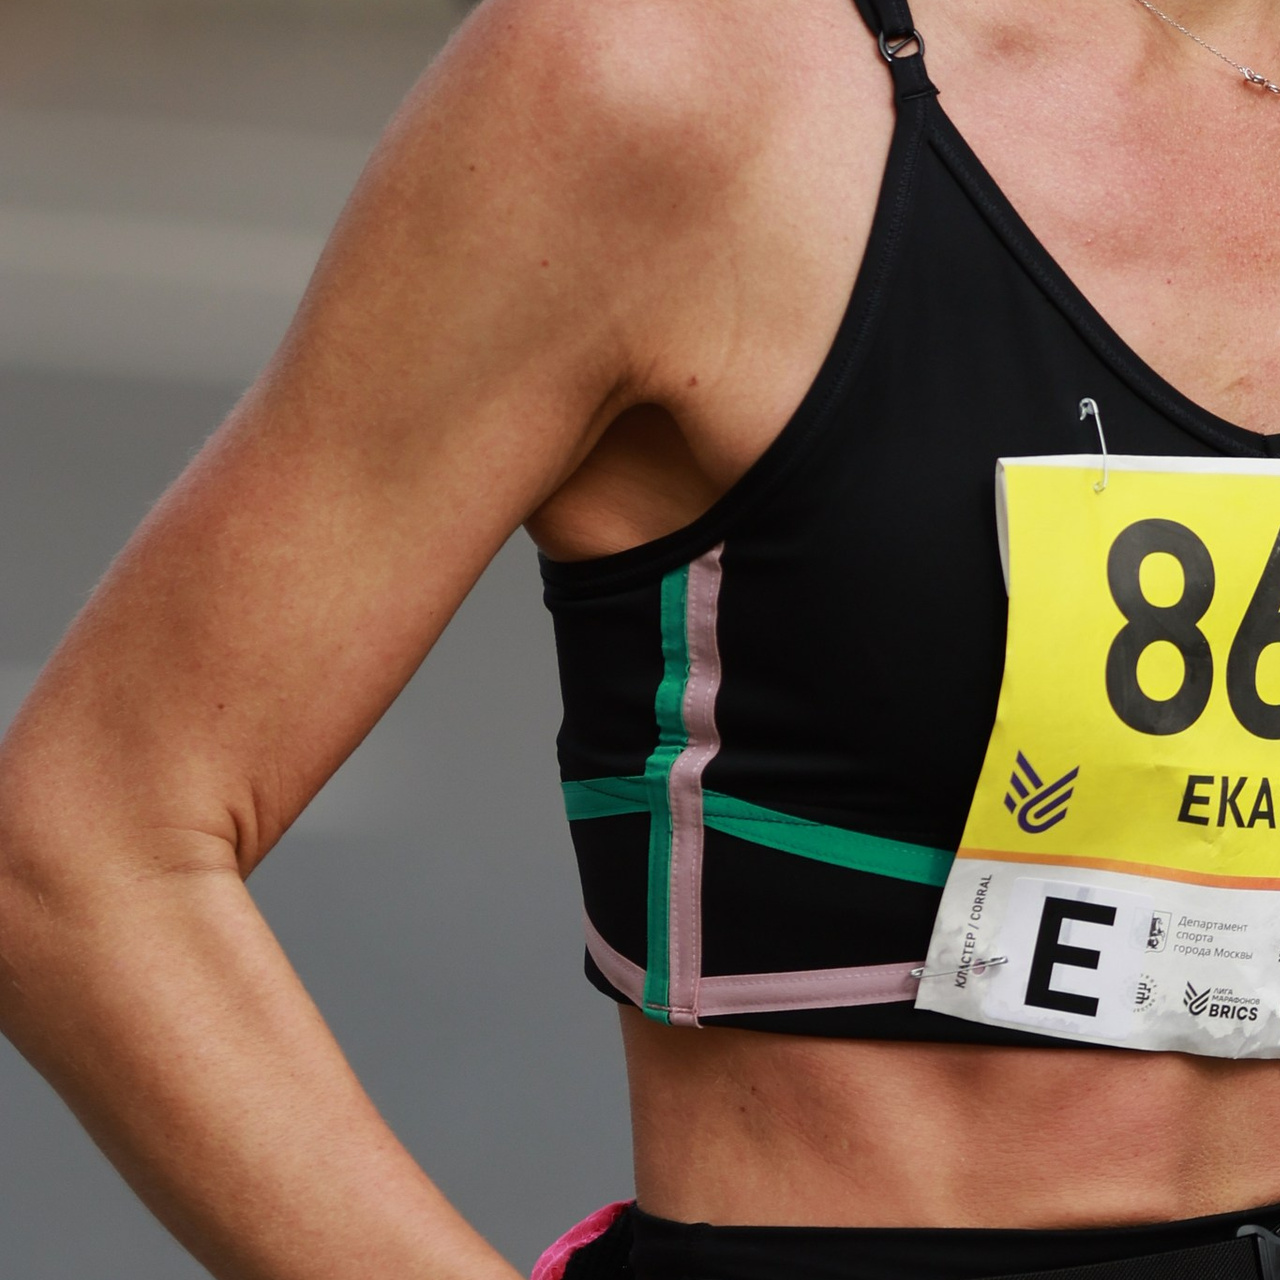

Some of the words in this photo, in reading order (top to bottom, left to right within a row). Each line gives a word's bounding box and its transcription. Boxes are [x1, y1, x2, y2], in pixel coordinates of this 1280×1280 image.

[970, 873, 993, 921] CORRAL
[1178, 916, 1249, 933] Департамент
[1176, 930, 1214, 944] спорта
[1024, 895, 1118, 1017] E
[1173, 943, 1212, 957] города
[1213, 947, 1253, 961] Москвы
[1211, 994, 1261, 1006] МАРАФОНОВ
[1208, 1003, 1259, 1022] BRICS
